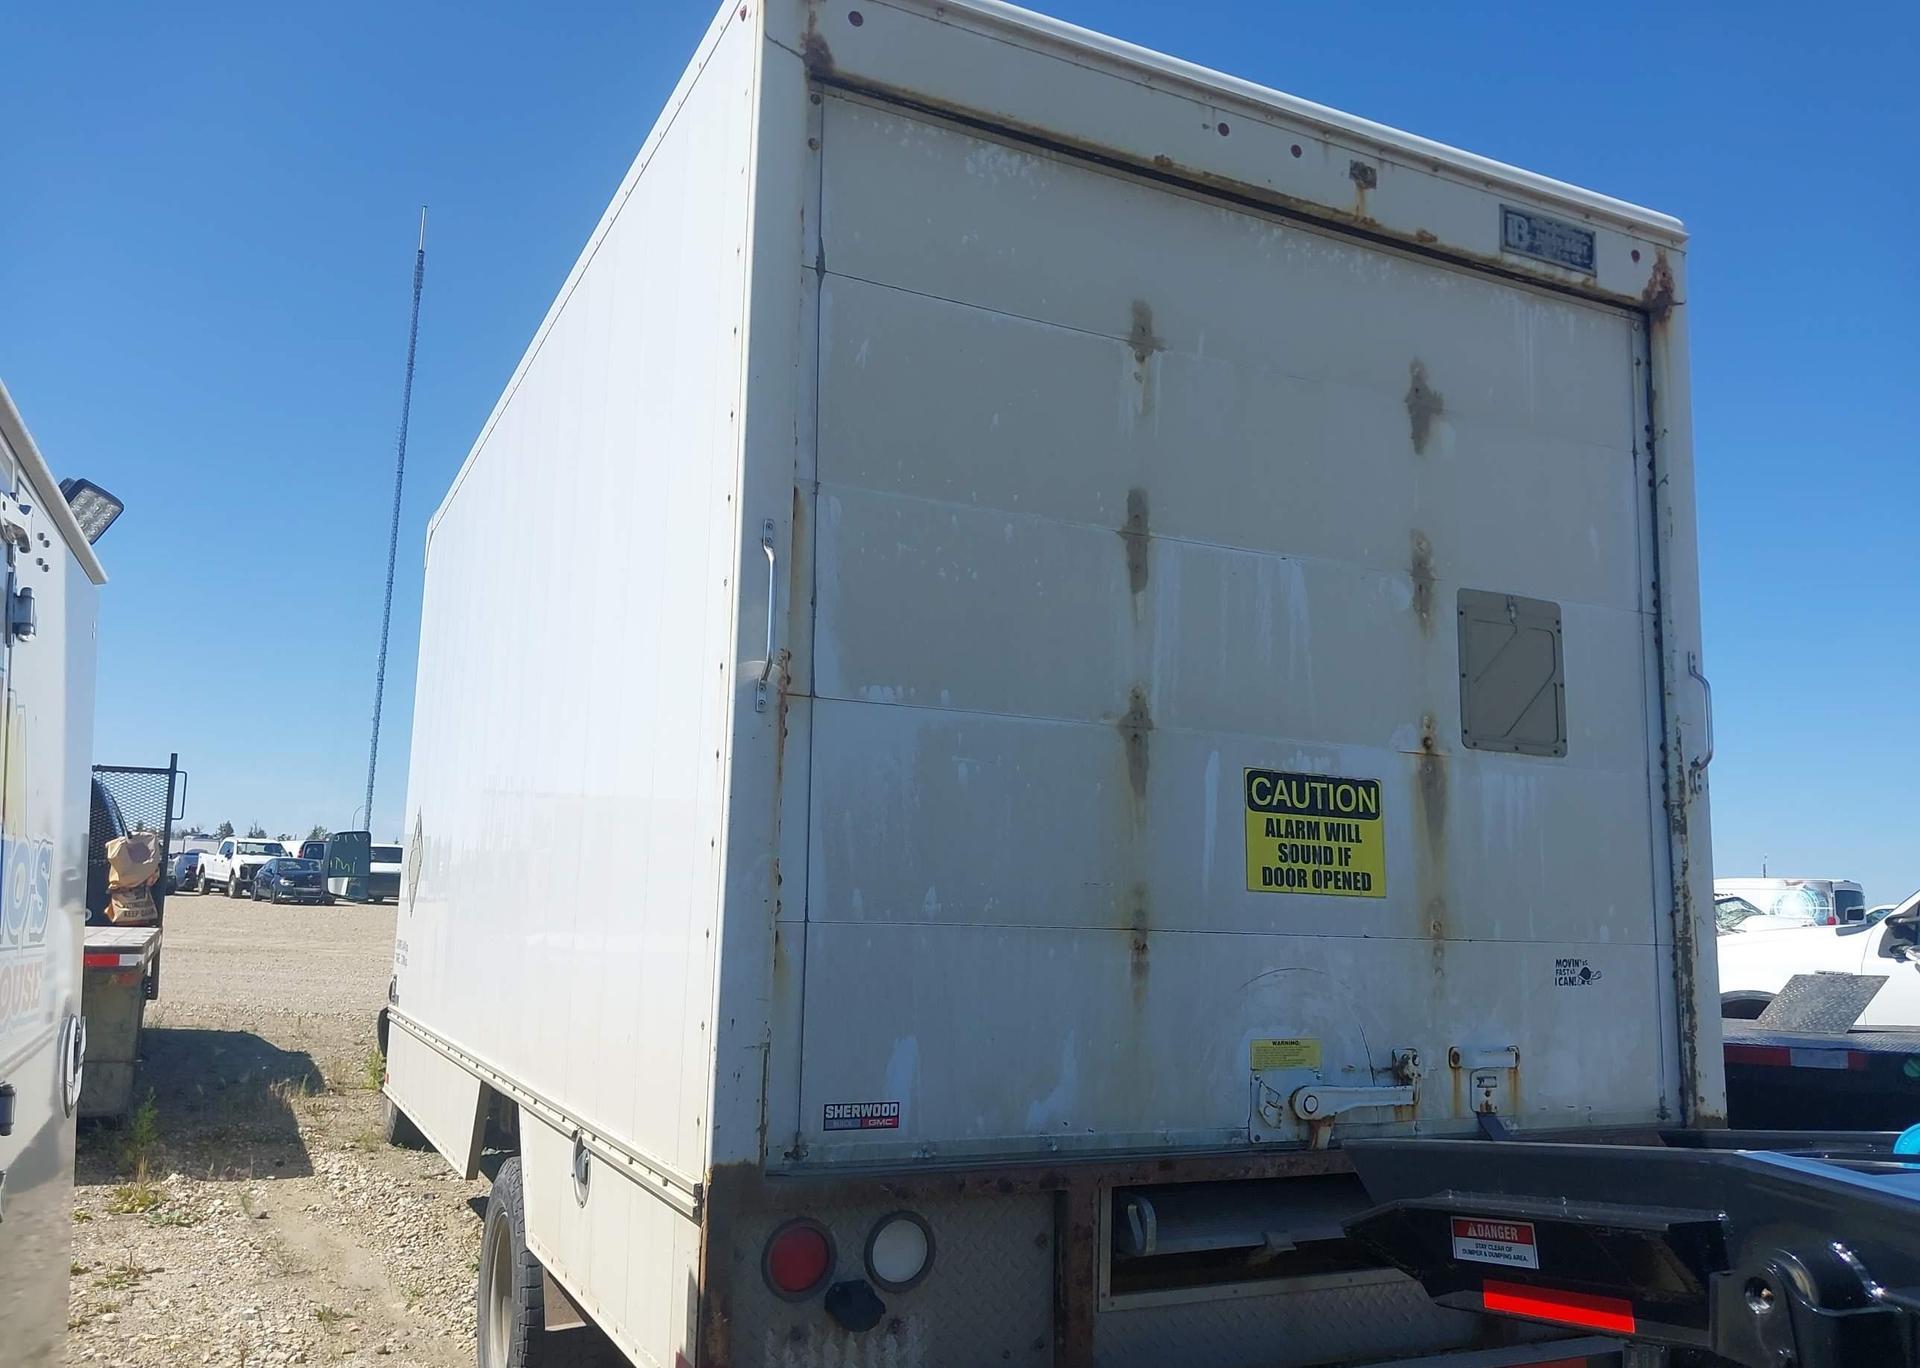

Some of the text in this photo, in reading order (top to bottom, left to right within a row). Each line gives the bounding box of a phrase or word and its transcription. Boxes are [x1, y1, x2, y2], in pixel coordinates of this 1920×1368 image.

[1251, 776, 1377, 814] CAUTION
[1265, 817, 1363, 844] ALARM WILL
[1277, 842, 1352, 867] SOUND IF
[1262, 866, 1372, 892] DOOR OPENED
[825, 1103, 898, 1119] SHERWOOD
[868, 1118, 893, 1126] GMC
[1477, 1223, 1519, 1241] DANGER
